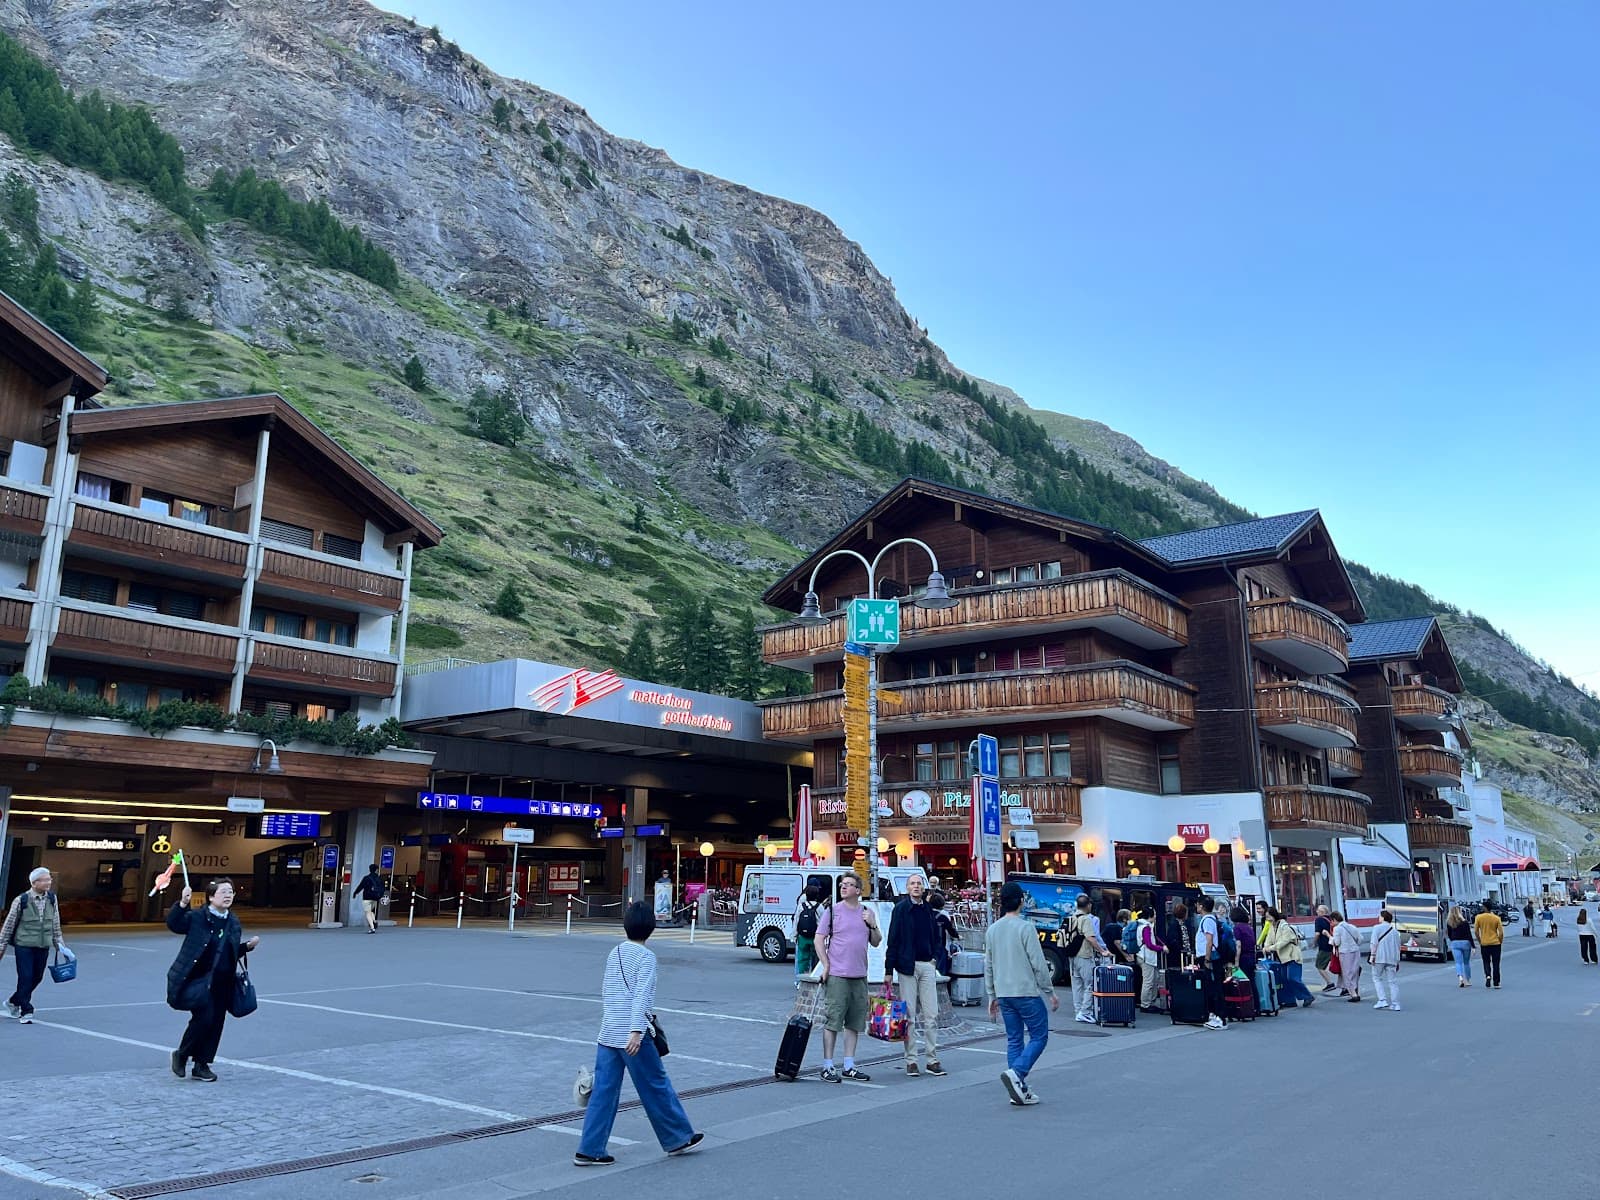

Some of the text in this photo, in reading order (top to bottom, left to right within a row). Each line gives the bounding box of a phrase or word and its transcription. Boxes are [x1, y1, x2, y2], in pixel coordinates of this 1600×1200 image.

[629, 690, 693, 710] matterhorn
[944, 791, 1021, 807] Pizia
[212, 821, 245, 837] Ber
[1182, 826, 1206, 836] ATM
[838, 832, 858, 842] ATM
[908, 830, 970, 843] Bahnhofbuf
